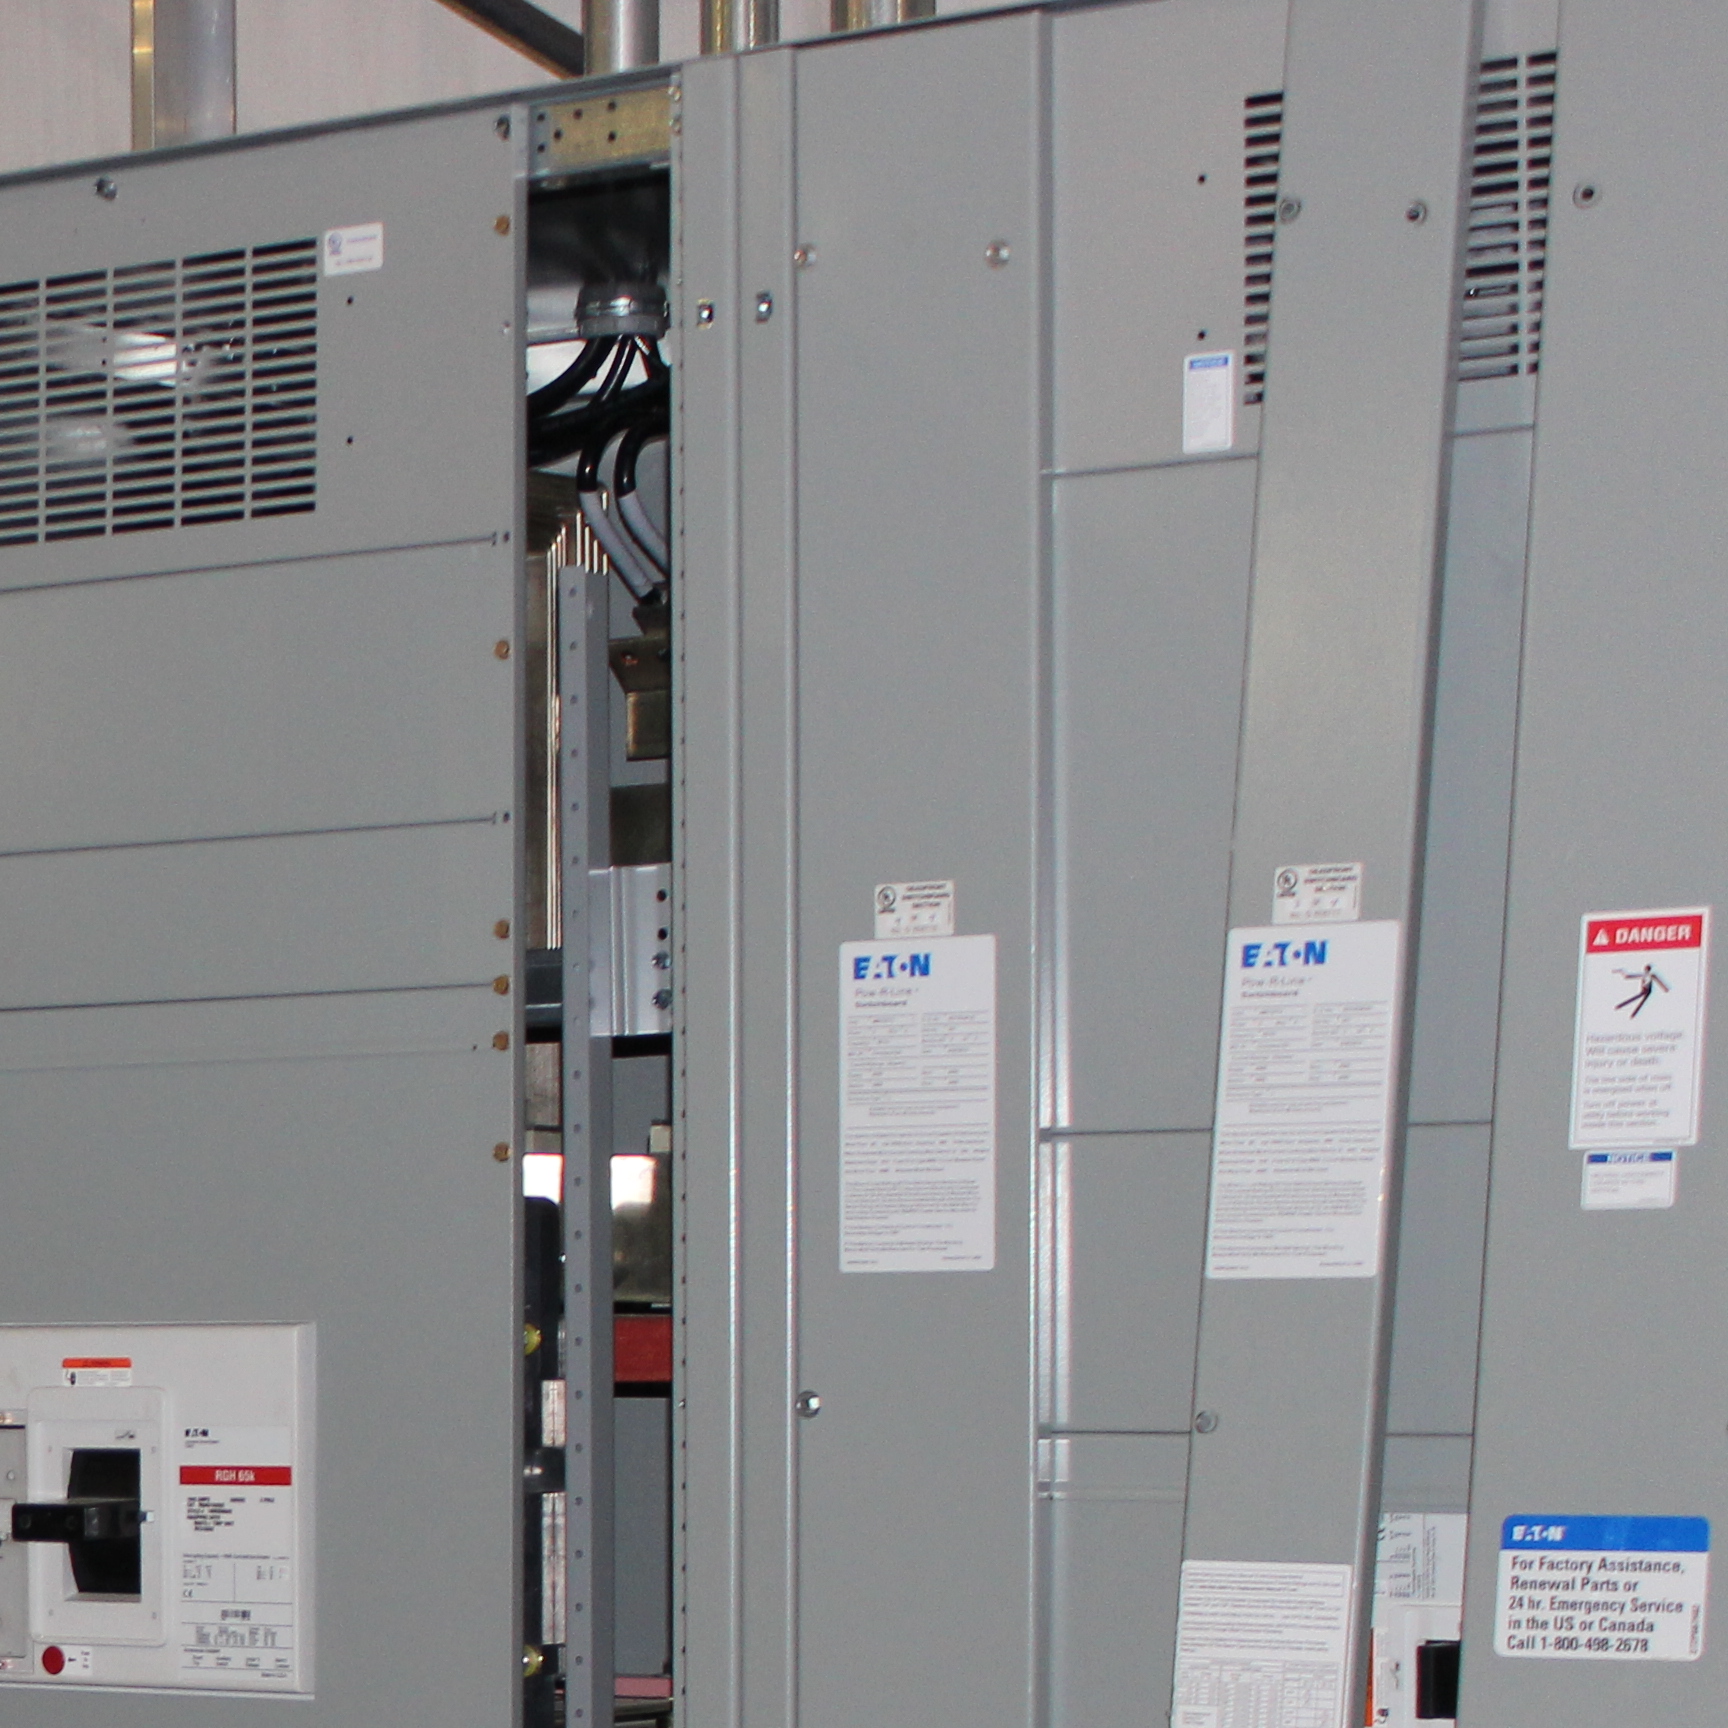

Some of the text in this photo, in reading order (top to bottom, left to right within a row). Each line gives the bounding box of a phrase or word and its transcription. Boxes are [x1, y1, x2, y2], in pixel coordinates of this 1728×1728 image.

[1615, 924, 1691, 944] DANGER
[1510, 1555, 1686, 1575] For Factory Assistance,
[1509, 1576, 1639, 1592] Renewal Parts or
[1508, 1595, 1524, 1610] 24
[1548, 1596, 1626, 1615] Emergency
[1629, 1598, 1683, 1614] Service
[1508, 1615, 1655, 1632] in the US or Canada
[1507, 1635, 1536, 1651] Call
